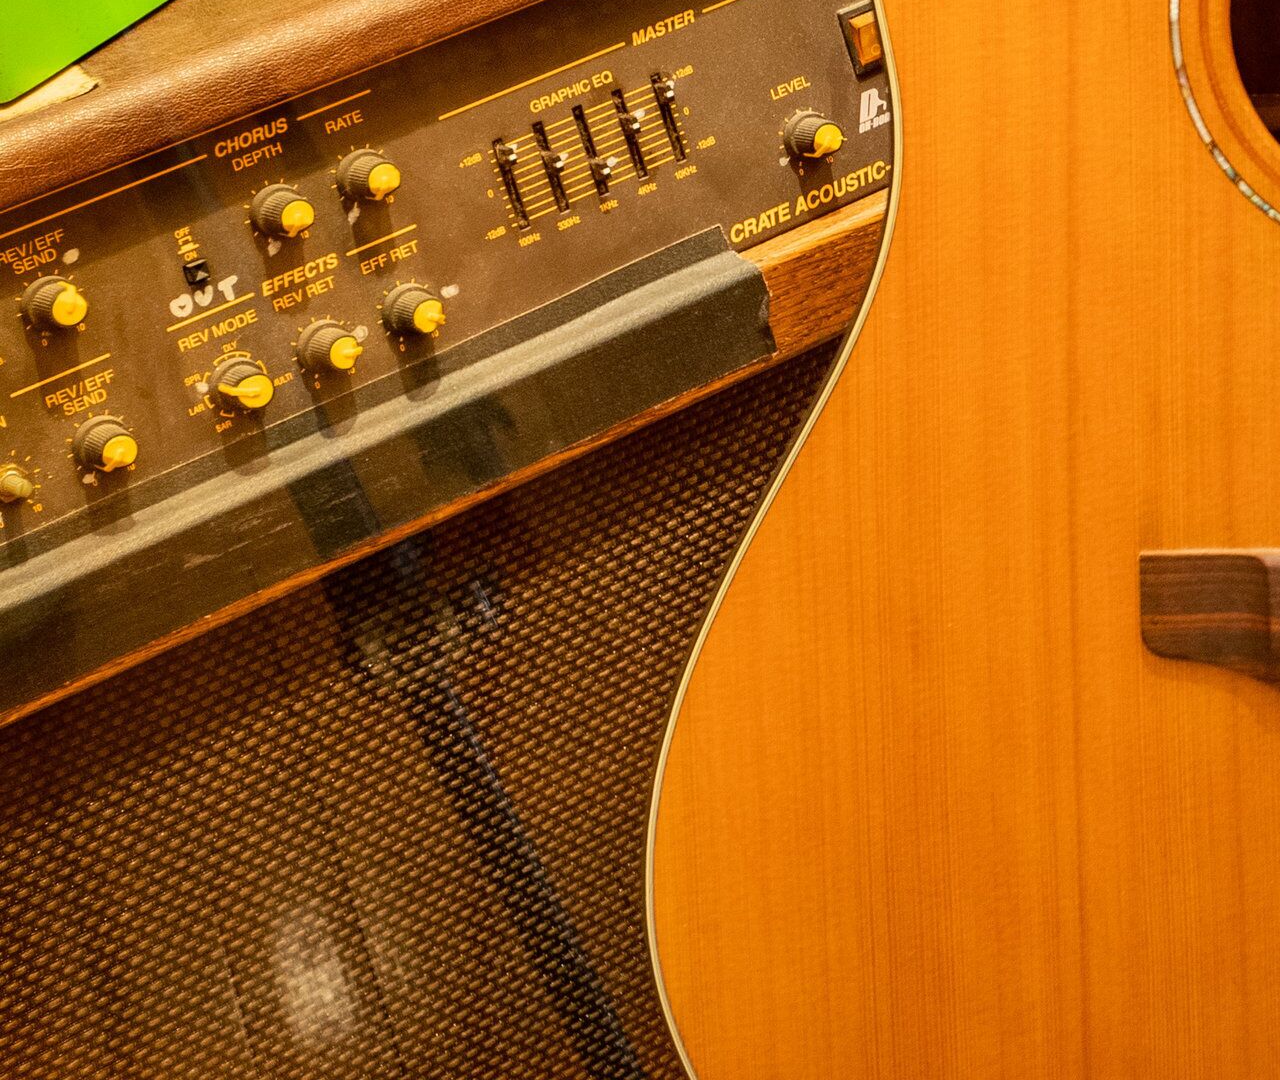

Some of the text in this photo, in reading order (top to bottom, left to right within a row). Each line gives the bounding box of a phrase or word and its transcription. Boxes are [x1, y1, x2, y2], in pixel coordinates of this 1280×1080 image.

[632, 8, 696, 47] MASTER
[671, 64, 694, 81] +12dB
[529, 70, 615, 114] GRAPHIC EQ
[770, 75, 811, 101] LEVEL
[683, 106, 690, 117] 0
[324, 109, 364, 135] RATE
[214, 117, 289, 158] CHORUS
[695, 135, 716, 151] -12dB
[231, 141, 283, 172] DEPTH
[458, 151, 483, 169] +12dB
[674, 164, 698, 181] 10KHz
[487, 188, 494, 199] 0
[637, 180, 658, 197] 4KHz
[599, 197, 620, 214] 1KHz
[556, 214, 581, 232] 330Hz
[729, 201, 792, 244] CRATE
[174, 226, 192, 240] OFF
[484, 224, 507, 242] -12dB
[517, 231, 541, 248] 100Hz
[12, 247, 57, 275] SEND
[184, 250, 198, 261] ON
[360, 239, 419, 276] EFF RET
[261, 252, 339, 297] EFFECTS
[169, 274, 238, 318] OUT
[272, 275, 335, 313] REV RET
[177, 308, 259, 353] REV MODE
[222, 340, 238, 353] DLY
[45, 368, 115, 409] REV/EFF
[184, 372, 202, 388] SPR
[63, 388, 108, 416] SEND
[188, 402, 205, 417] LAR
